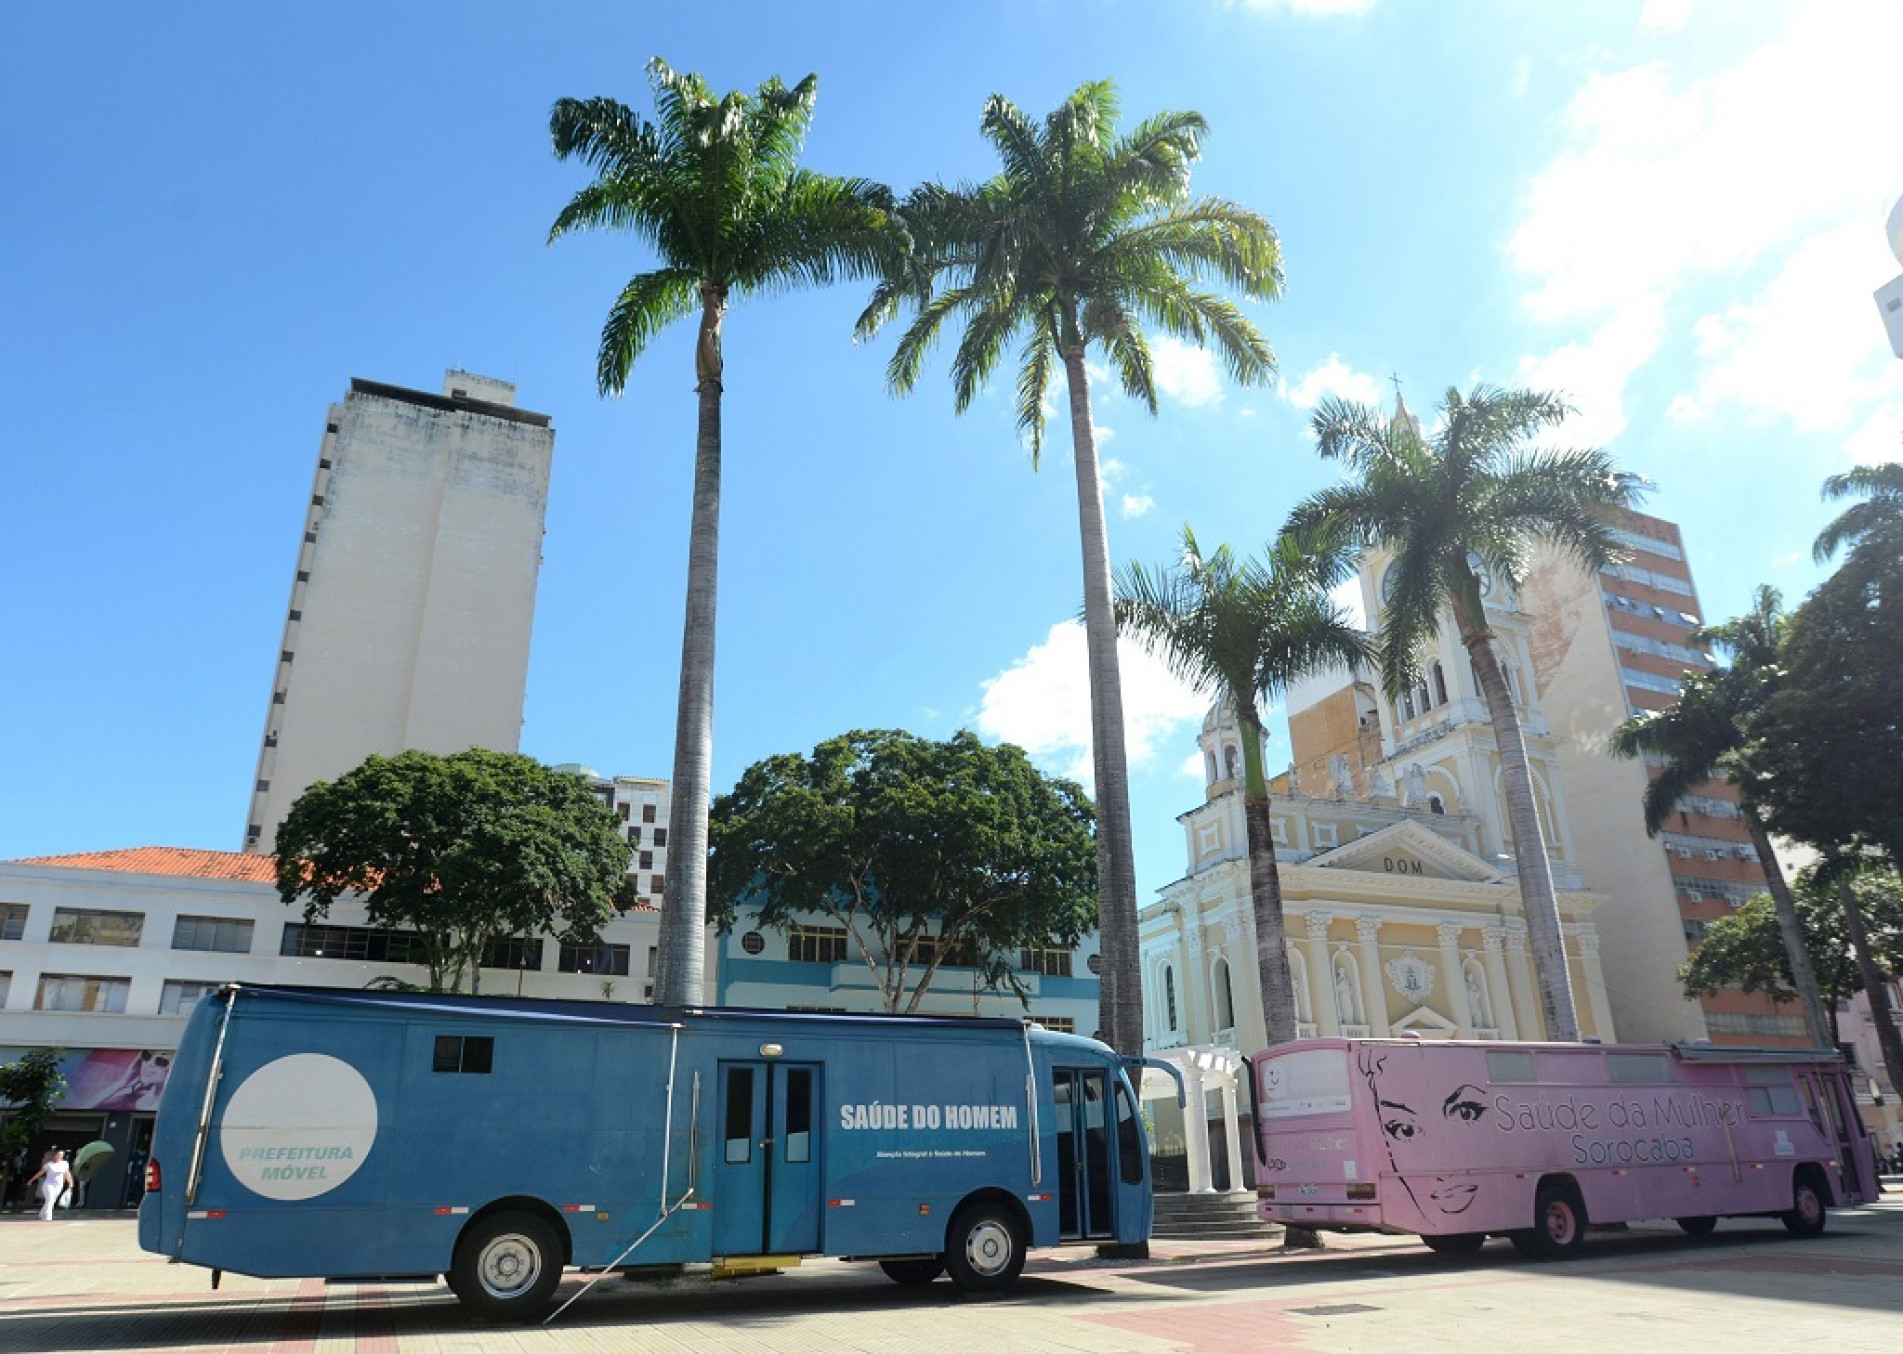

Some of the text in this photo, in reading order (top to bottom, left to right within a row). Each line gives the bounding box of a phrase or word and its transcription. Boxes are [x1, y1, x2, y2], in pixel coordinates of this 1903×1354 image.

[1383, 857, 1422, 875] DOM
[840, 1100, 1017, 1130] SAÚDE DO HOMEM
[1607, 1094, 1647, 1128] da
[1653, 1095, 1744, 1128] Mulher
[238, 1147, 353, 1160] PREFEITURA
[1571, 1133, 1694, 1164] Sorocaba
[261, 1164, 327, 1181] MÓVEL
